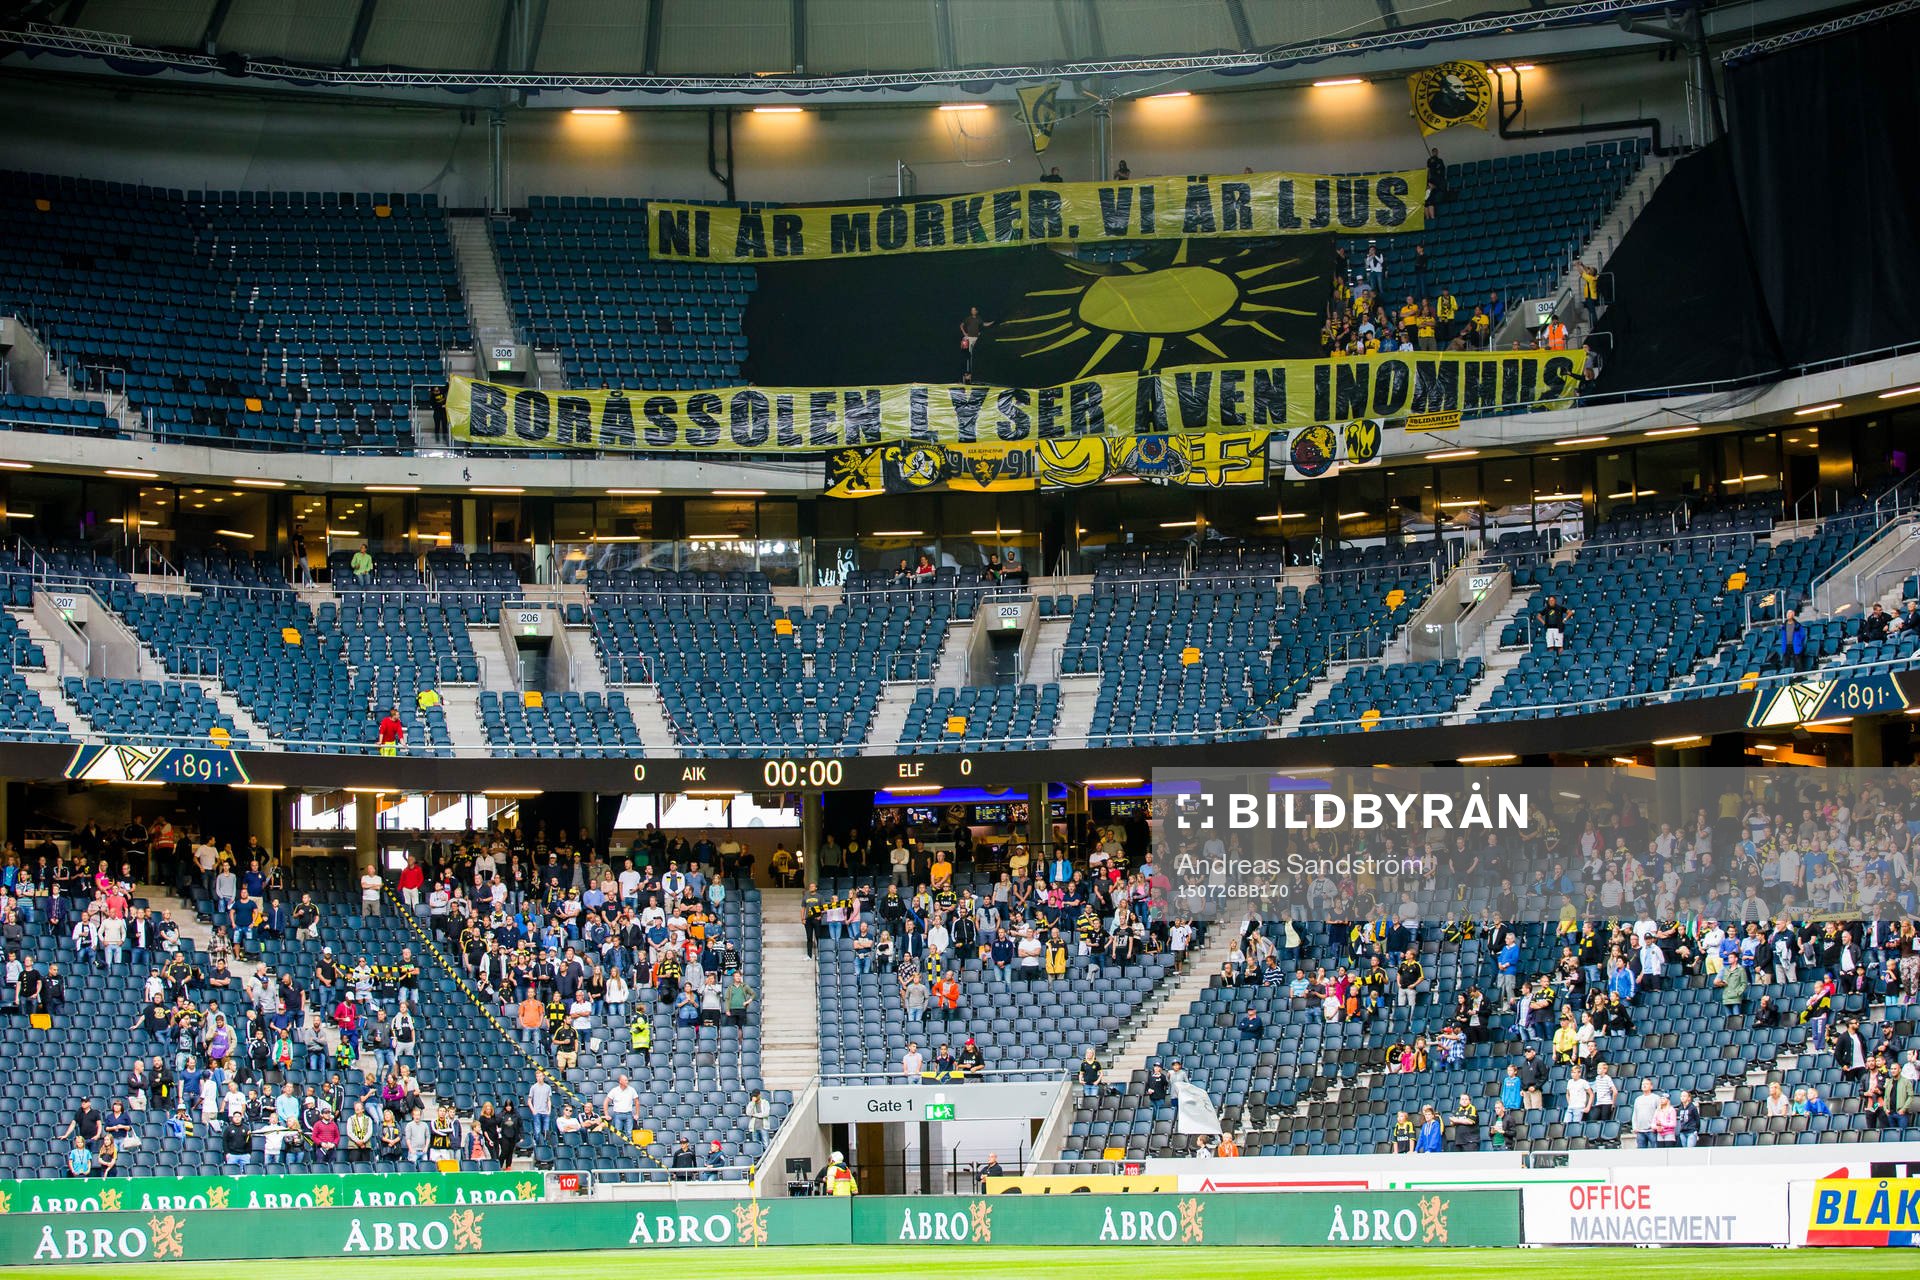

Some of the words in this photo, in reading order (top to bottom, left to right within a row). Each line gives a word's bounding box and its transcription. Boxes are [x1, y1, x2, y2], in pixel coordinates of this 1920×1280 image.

[659, 209, 711, 258] NI
[735, 207, 805, 257] ÄR
[831, 189, 1079, 254] MÖRKER.
[1098, 184, 1155, 236] VI
[1183, 175, 1253, 233] ÄR
[1278, 176, 1409, 230] LJUS
[1538, 303, 1554, 312] 304
[495, 348, 512, 358] 306
[470, 382, 881, 447] BORÅSSOLEN
[910, 381, 1104, 443] LYSER
[1135, 367, 1286, 433] ÄVEN
[1473, 577, 1489, 588] 204
[57, 598, 73, 607] 207
[1001, 607, 1018, 616] 205
[521, 613, 538, 623] 206
[1840, 683, 1883, 710] 1891
[174, 753, 222, 781] 1891
[633, 764, 645, 782] 0
[682, 765, 706, 782] AIK
[763, 759, 843, 787] 00:00
[899, 762, 926, 778] ELF
[960, 758, 972, 776] 0
[867, 1099, 902, 1113] Gate
[906, 1099, 914, 1112] 1
[561, 1178, 577, 1187] 107
[31, 1195, 100, 1213] ÅBRO
[140, 1193, 208, 1210] ÅBRO
[247, 1190, 313, 1208] ÅBRO
[353, 1188, 417, 1206] ÅBRO
[454, 1187, 516, 1203] ÅBRO
[1569, 1184, 1651, 1210] OFFICE
[629, 1212, 731, 1243] ÅBRO
[899, 1207, 969, 1240] ÅBRO
[1099, 1206, 1178, 1241] ÅBRO
[1328, 1204, 1417, 1241] ÅBRO
[1570, 1215, 1737, 1242] MANAGEMENT
[34, 1224, 147, 1259] ÅBRO
[343, 1218, 449, 1251] ÅBRO
